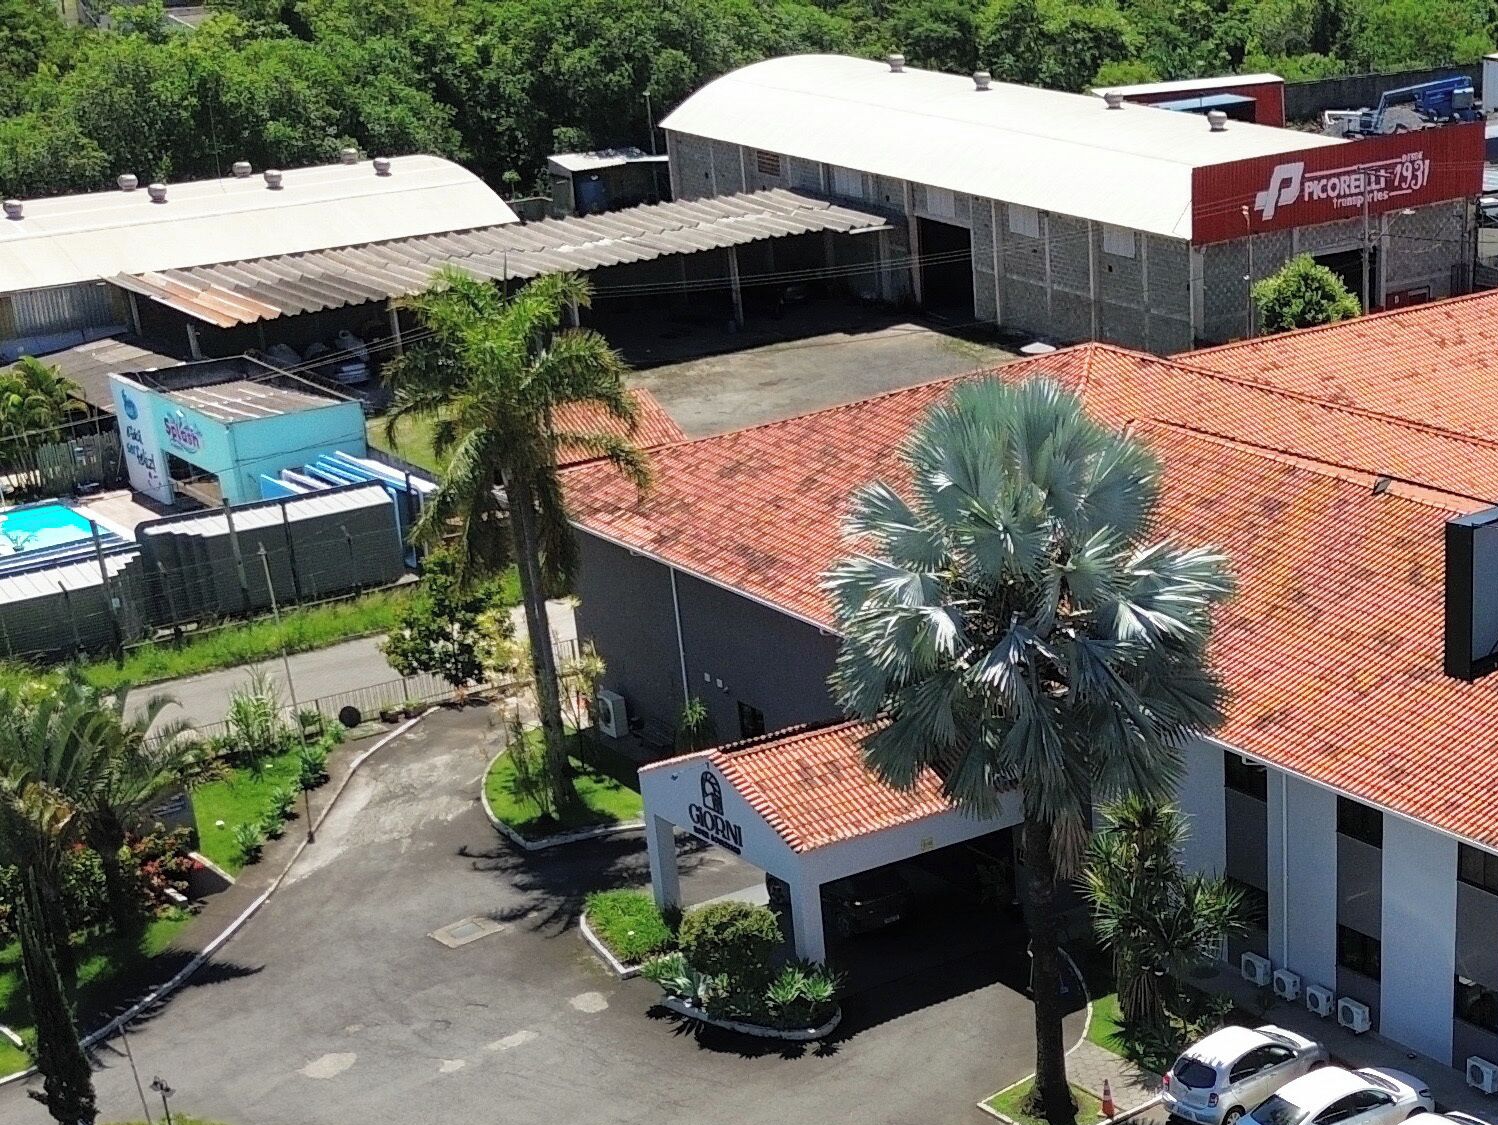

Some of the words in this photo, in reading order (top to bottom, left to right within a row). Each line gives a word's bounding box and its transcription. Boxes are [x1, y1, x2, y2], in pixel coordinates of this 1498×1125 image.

[1394, 159, 1430, 190] 1931
[1333, 190, 1389, 210] transprtes
[688, 803, 743, 848] GIORNI
